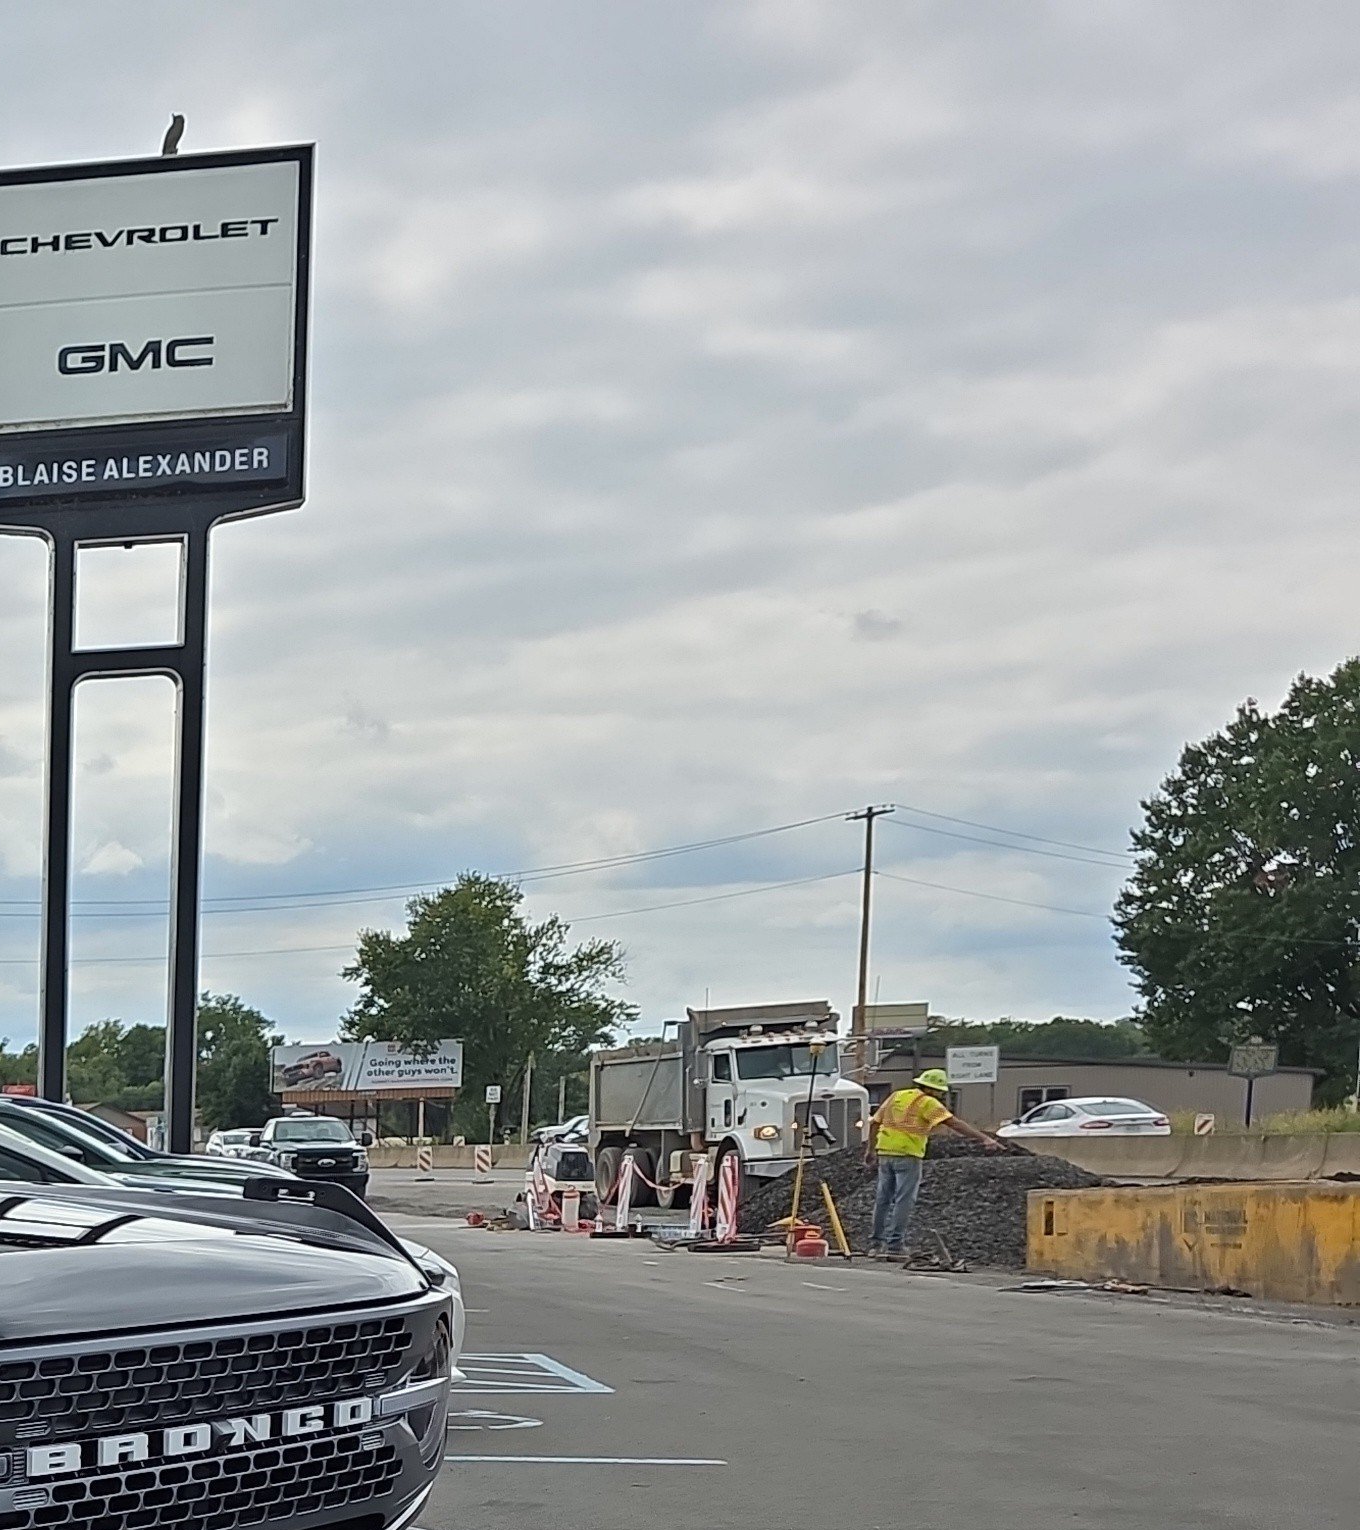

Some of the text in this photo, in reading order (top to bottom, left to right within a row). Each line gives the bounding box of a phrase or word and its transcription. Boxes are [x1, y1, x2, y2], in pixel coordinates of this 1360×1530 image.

[0, 217, 279, 256] CHEVROLET
[57, 336, 215, 375] GMC
[103, 446, 270, 481] ALEXANDER
[366, 1068, 395, 1077] other
[397, 1067, 422, 1077] guys
[369, 1055, 457, 1068] Going where the
[27, 1395, 373, 1478] BRONCO
